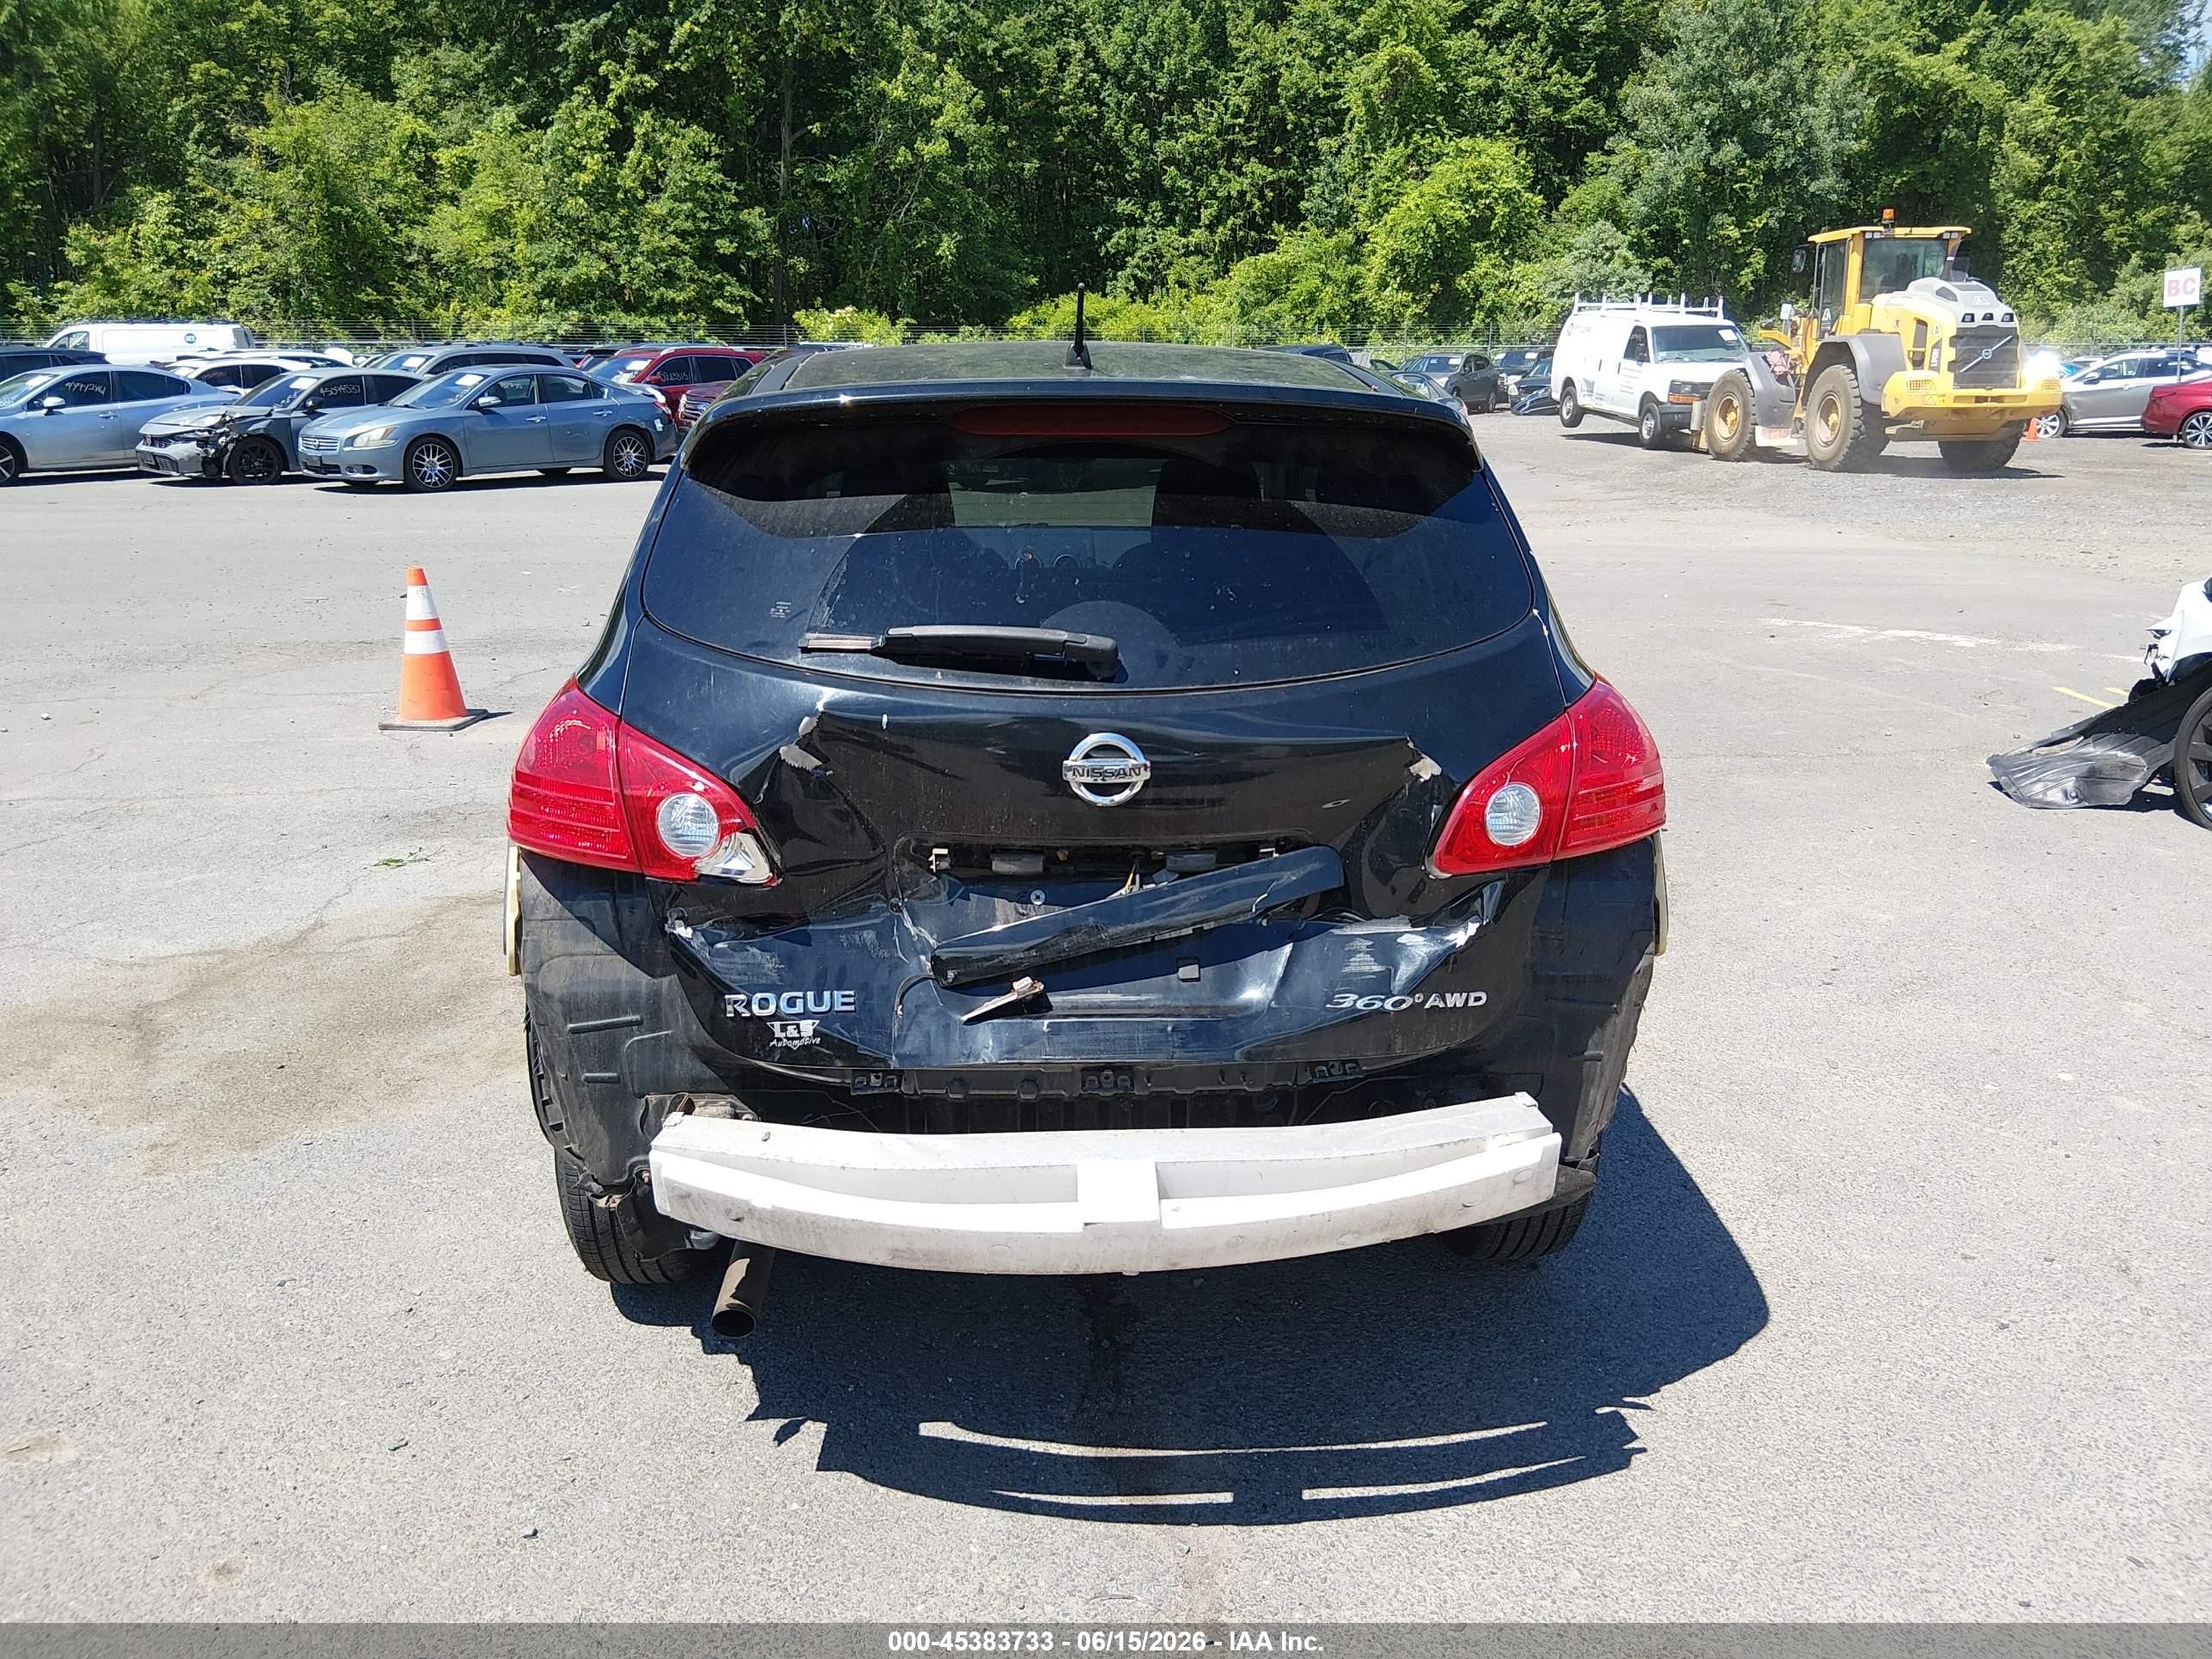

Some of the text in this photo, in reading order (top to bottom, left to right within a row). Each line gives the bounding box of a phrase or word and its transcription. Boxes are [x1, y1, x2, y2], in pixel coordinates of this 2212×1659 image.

[2167, 276, 2196, 297] BC
[1072, 767, 1141, 779] NISSAN
[724, 990, 856, 1018] ROGUE
[773, 1020, 815, 1038] L&S
[769, 1036, 822, 1048] Automotive
